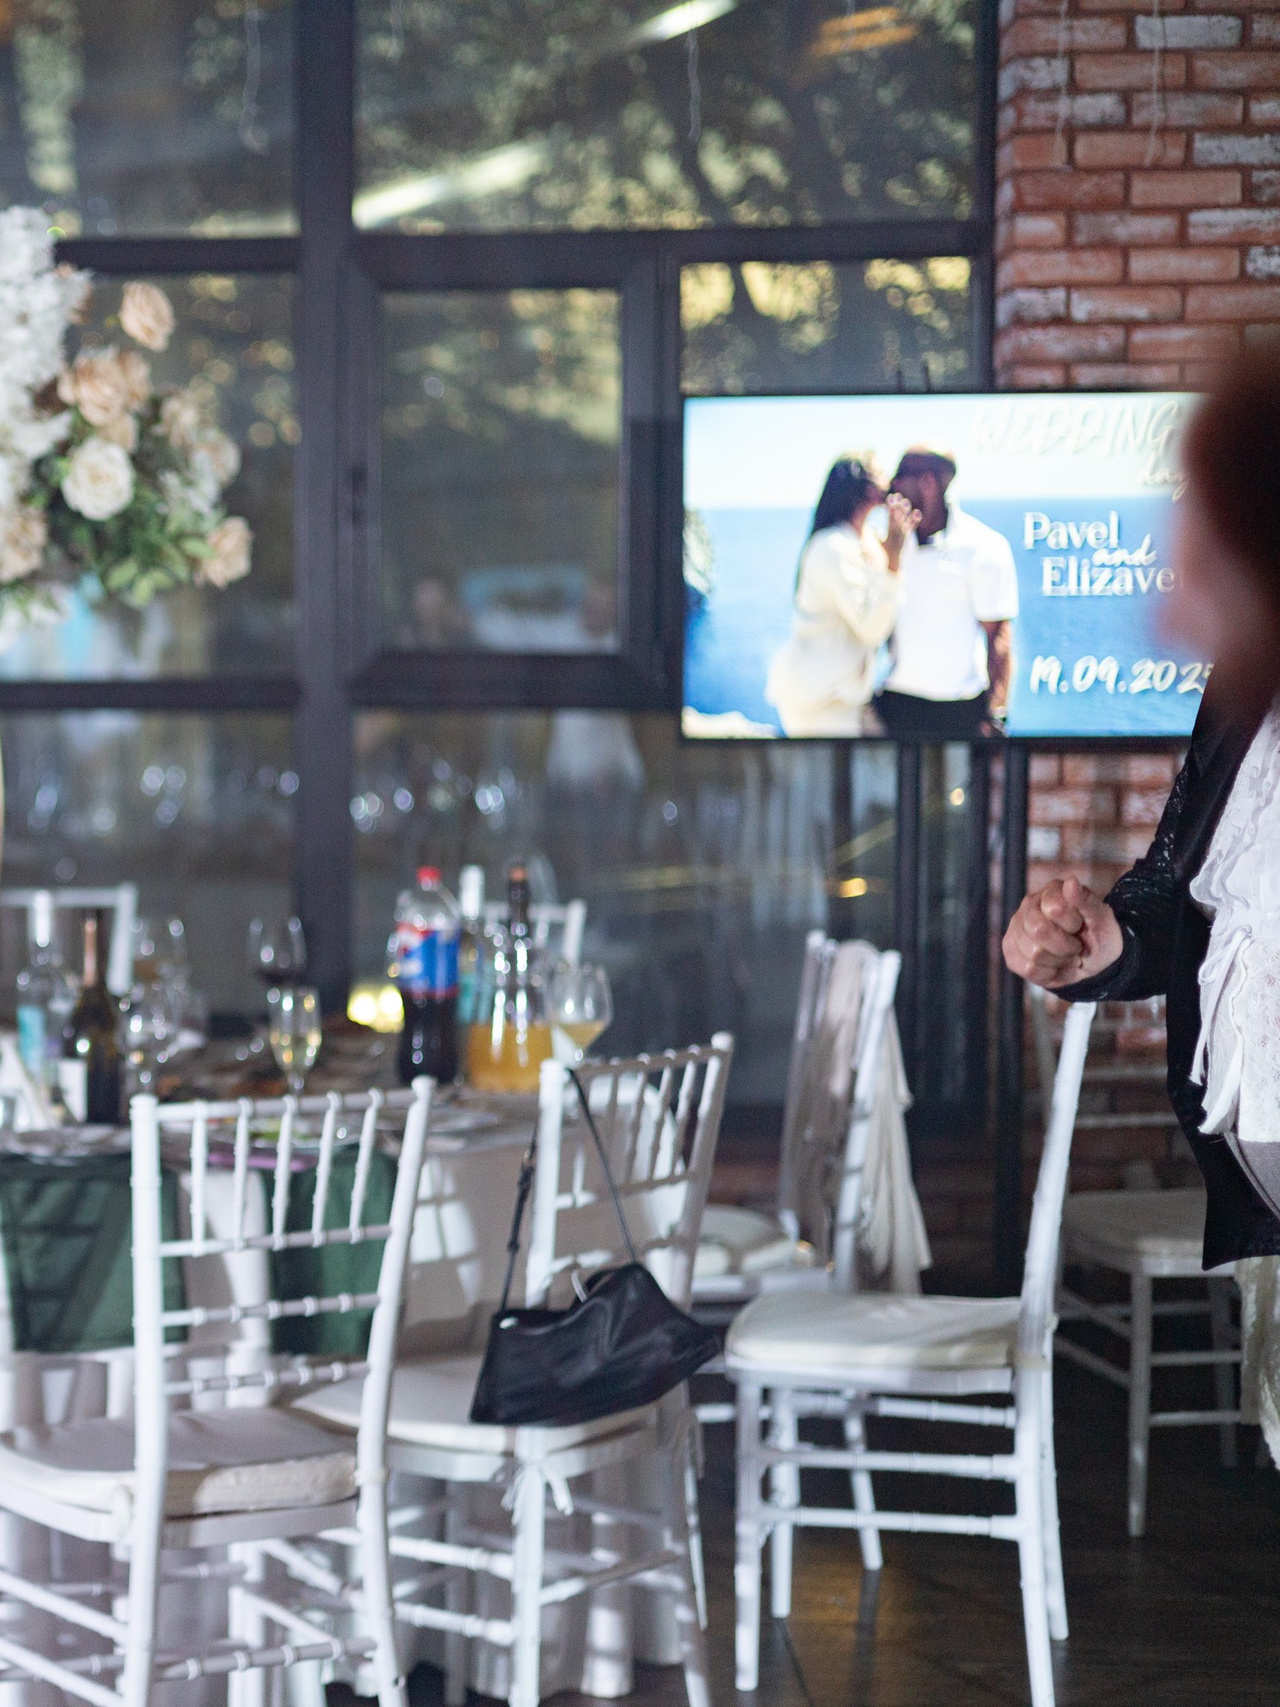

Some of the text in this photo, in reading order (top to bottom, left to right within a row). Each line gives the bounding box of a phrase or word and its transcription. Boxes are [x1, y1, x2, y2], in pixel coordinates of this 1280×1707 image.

[969, 399, 1179, 456] WEDDING
[1137, 450, 1189, 502] day
[1023, 510, 1119, 550] Pavel
[1092, 532, 1157, 567] and
[1042, 556, 1183, 597] Elizave
